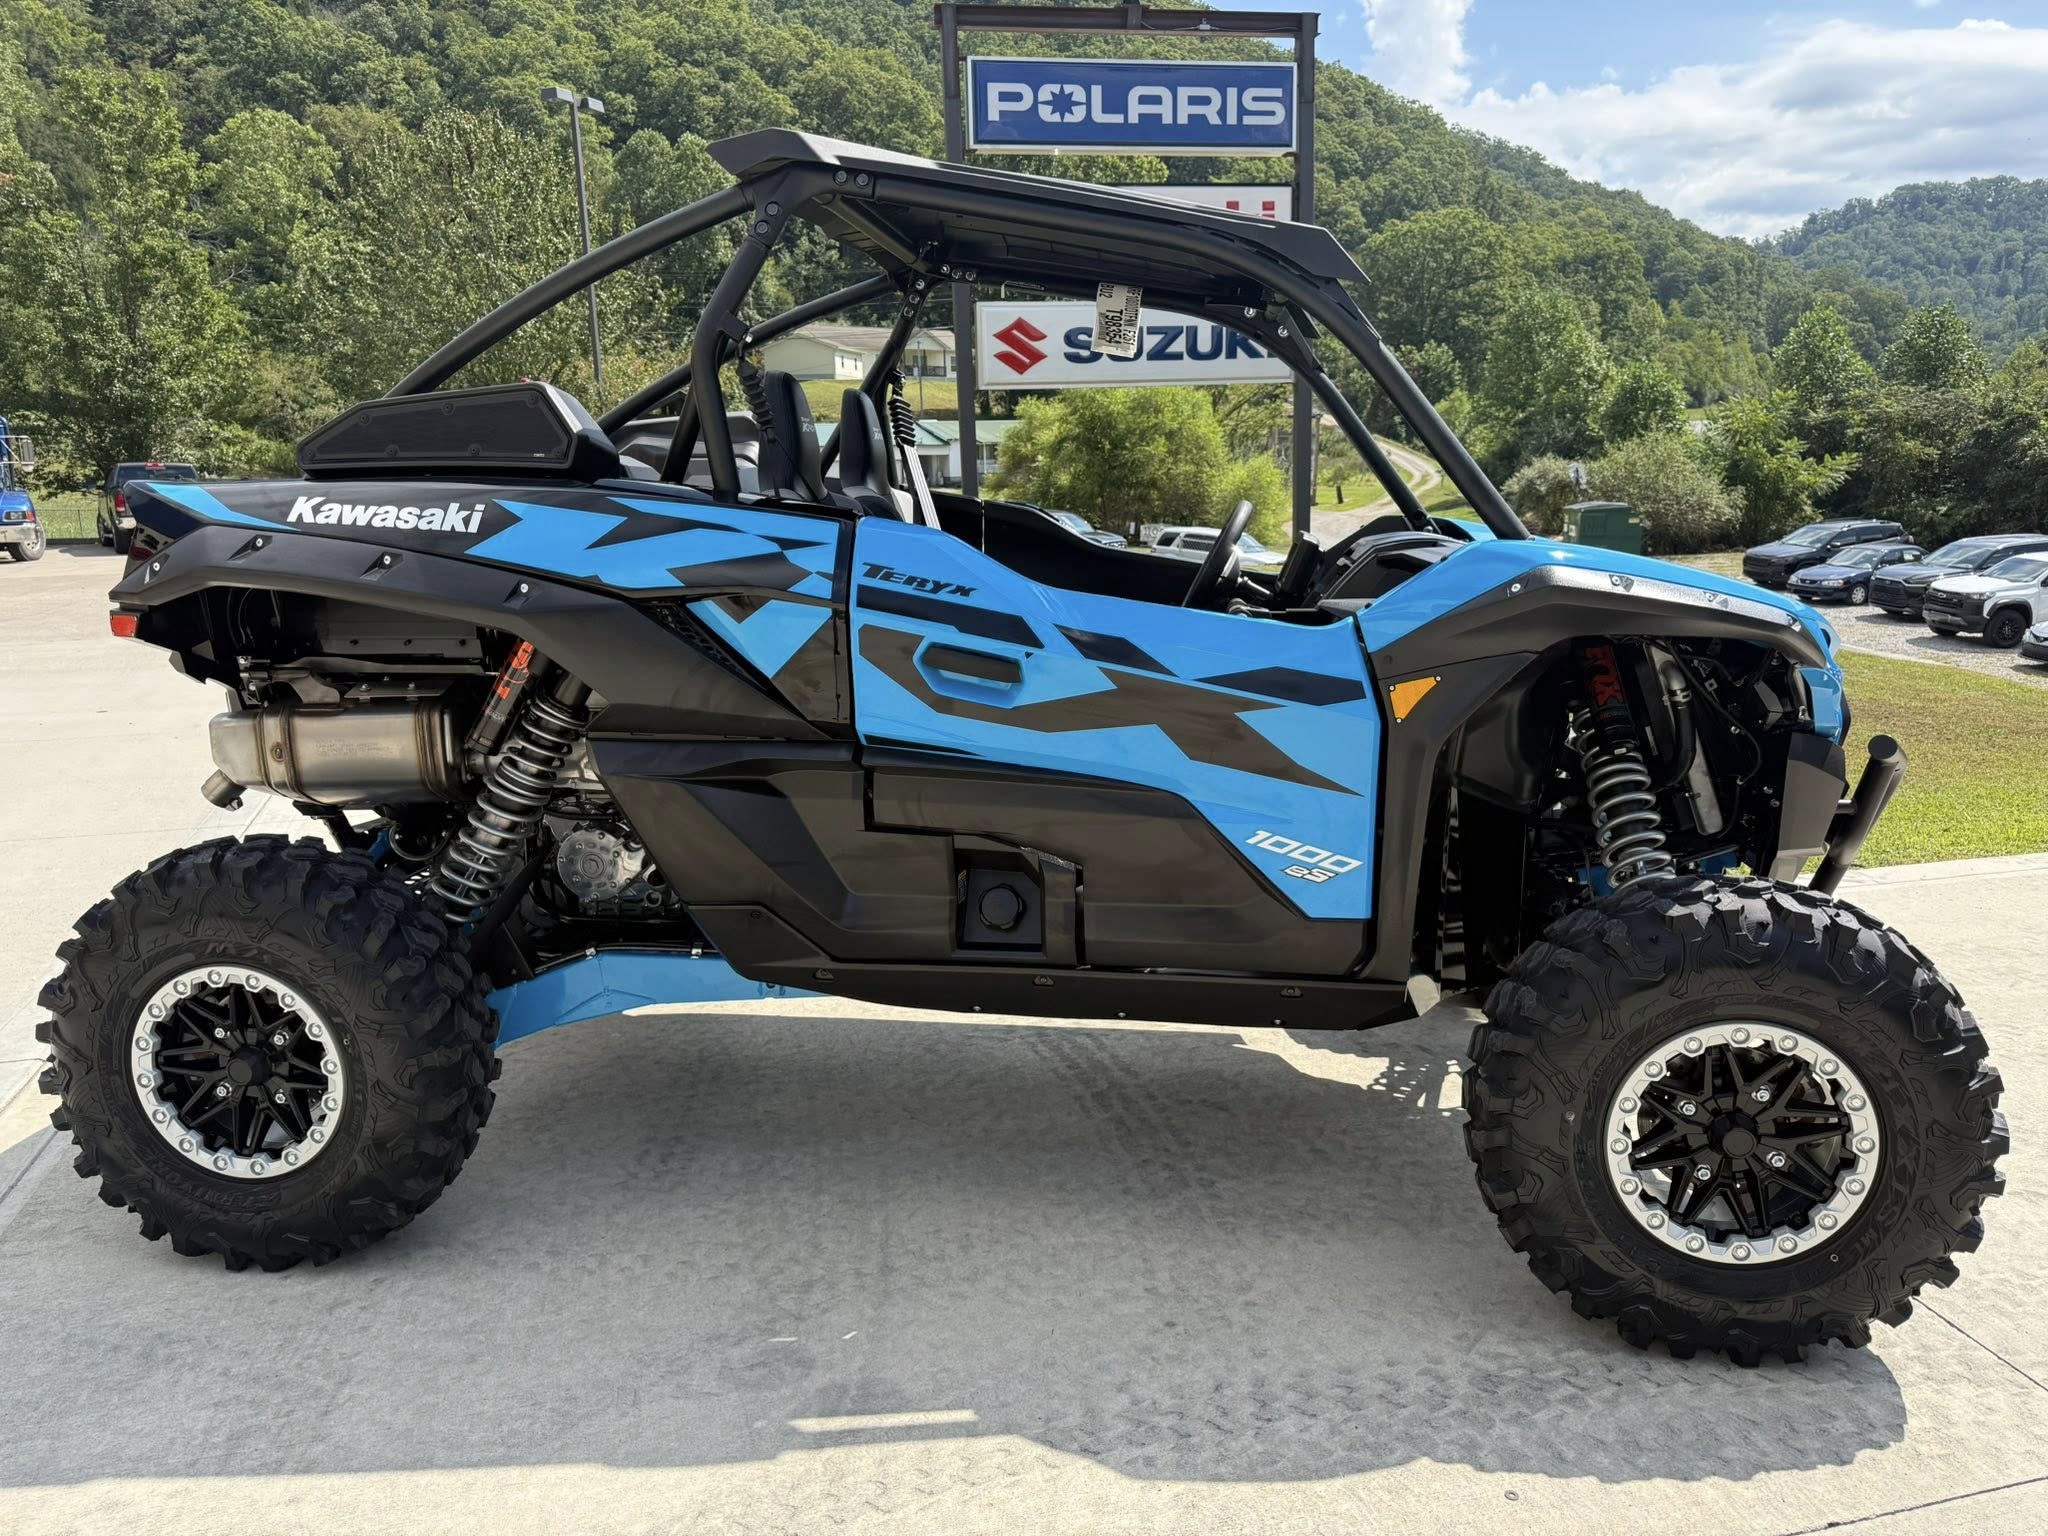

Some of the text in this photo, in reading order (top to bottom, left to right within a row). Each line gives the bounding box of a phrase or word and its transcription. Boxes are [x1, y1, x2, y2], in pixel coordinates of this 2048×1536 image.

[986, 82, 1287, 126] POLARIS
[1063, 325, 1277, 364] SZUK
[1104, 309, 1124, 345] T98354
[286, 496, 486, 534] Kawasaki
[1245, 830, 1364, 873] 1000
